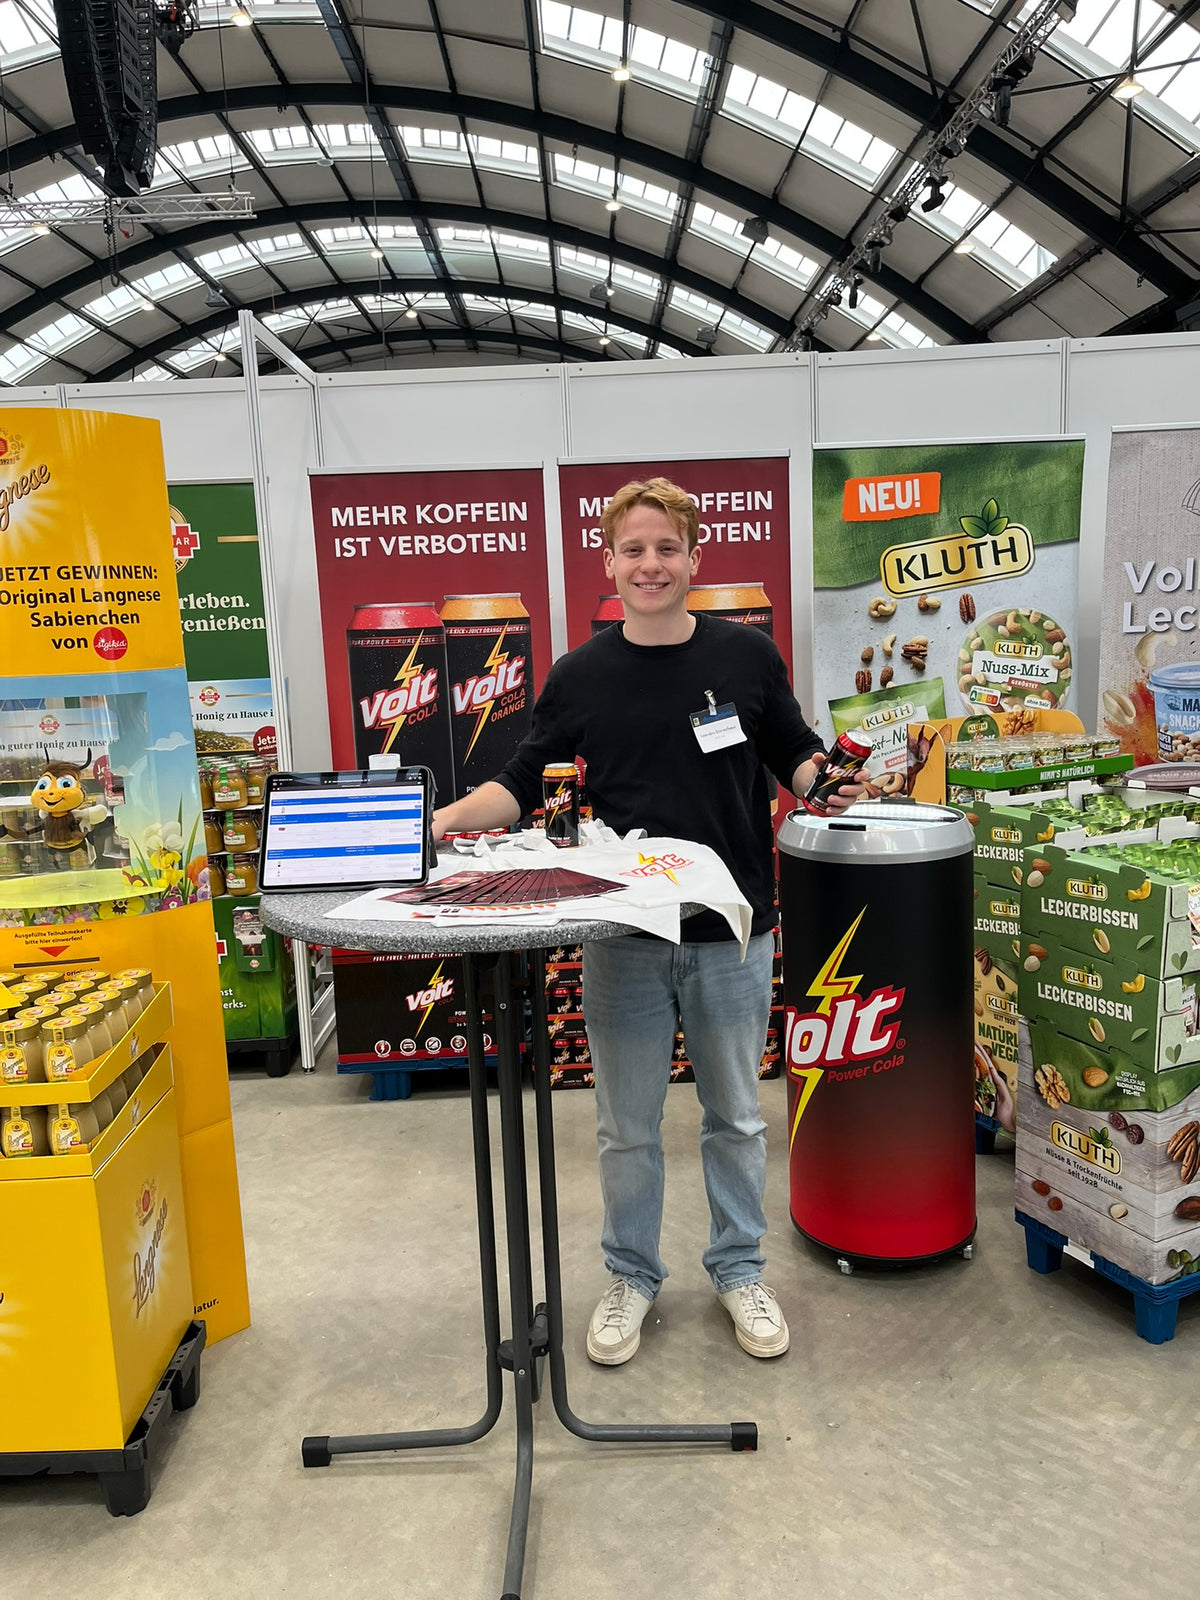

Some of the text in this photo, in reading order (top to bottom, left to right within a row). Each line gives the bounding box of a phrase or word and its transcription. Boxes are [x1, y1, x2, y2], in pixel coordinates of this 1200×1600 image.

[858, 478, 920, 514] NEU!
[331, 501, 528, 527] MEHR KOFFEIN
[334, 532, 527, 557] IST VERBOTEN!
[581, 527, 605, 549] IS
[895, 536, 1018, 584] KLUTH
[56, 565, 158, 580] GEWINNEN:
[1123, 557, 1200, 594] Vol
[0, 588, 161, 608] Original Langnese
[30, 610, 140, 628] Sabienchen
[181, 614, 266, 635] enießen
[51, 637, 88, 650] von
[998, 643, 1039, 656] KLUTH
[981, 660, 1050, 678] Nuss-Mix
[452, 654, 526, 717] Volt
[360, 668, 439, 730] Volt
[500, 690, 526, 708] COLA
[196, 711, 224, 722] Honig
[240, 710, 269, 718] Hause
[407, 704, 438, 727] COLA
[490, 699, 526, 723] ORANGE
[865, 705, 910, 728] KLUTH
[545, 790, 572, 810] Volt
[993, 830, 1020, 841] KLUTH
[1070, 883, 1104, 896] KLUTH
[1041, 897, 1138, 930] LECKERBISSEN
[1066, 970, 1100, 985] KLUTH
[405, 980, 453, 1011] Volt
[1038, 982, 1133, 1022] LECKERBISSEN
[827, 1054, 904, 1084] Power Cola
[1058, 1128, 1114, 1169] KLUTH
[1068, 1169, 1098, 1188] seit 1928
[1073, 1161, 1123, 1191] Trockenfrüchte
